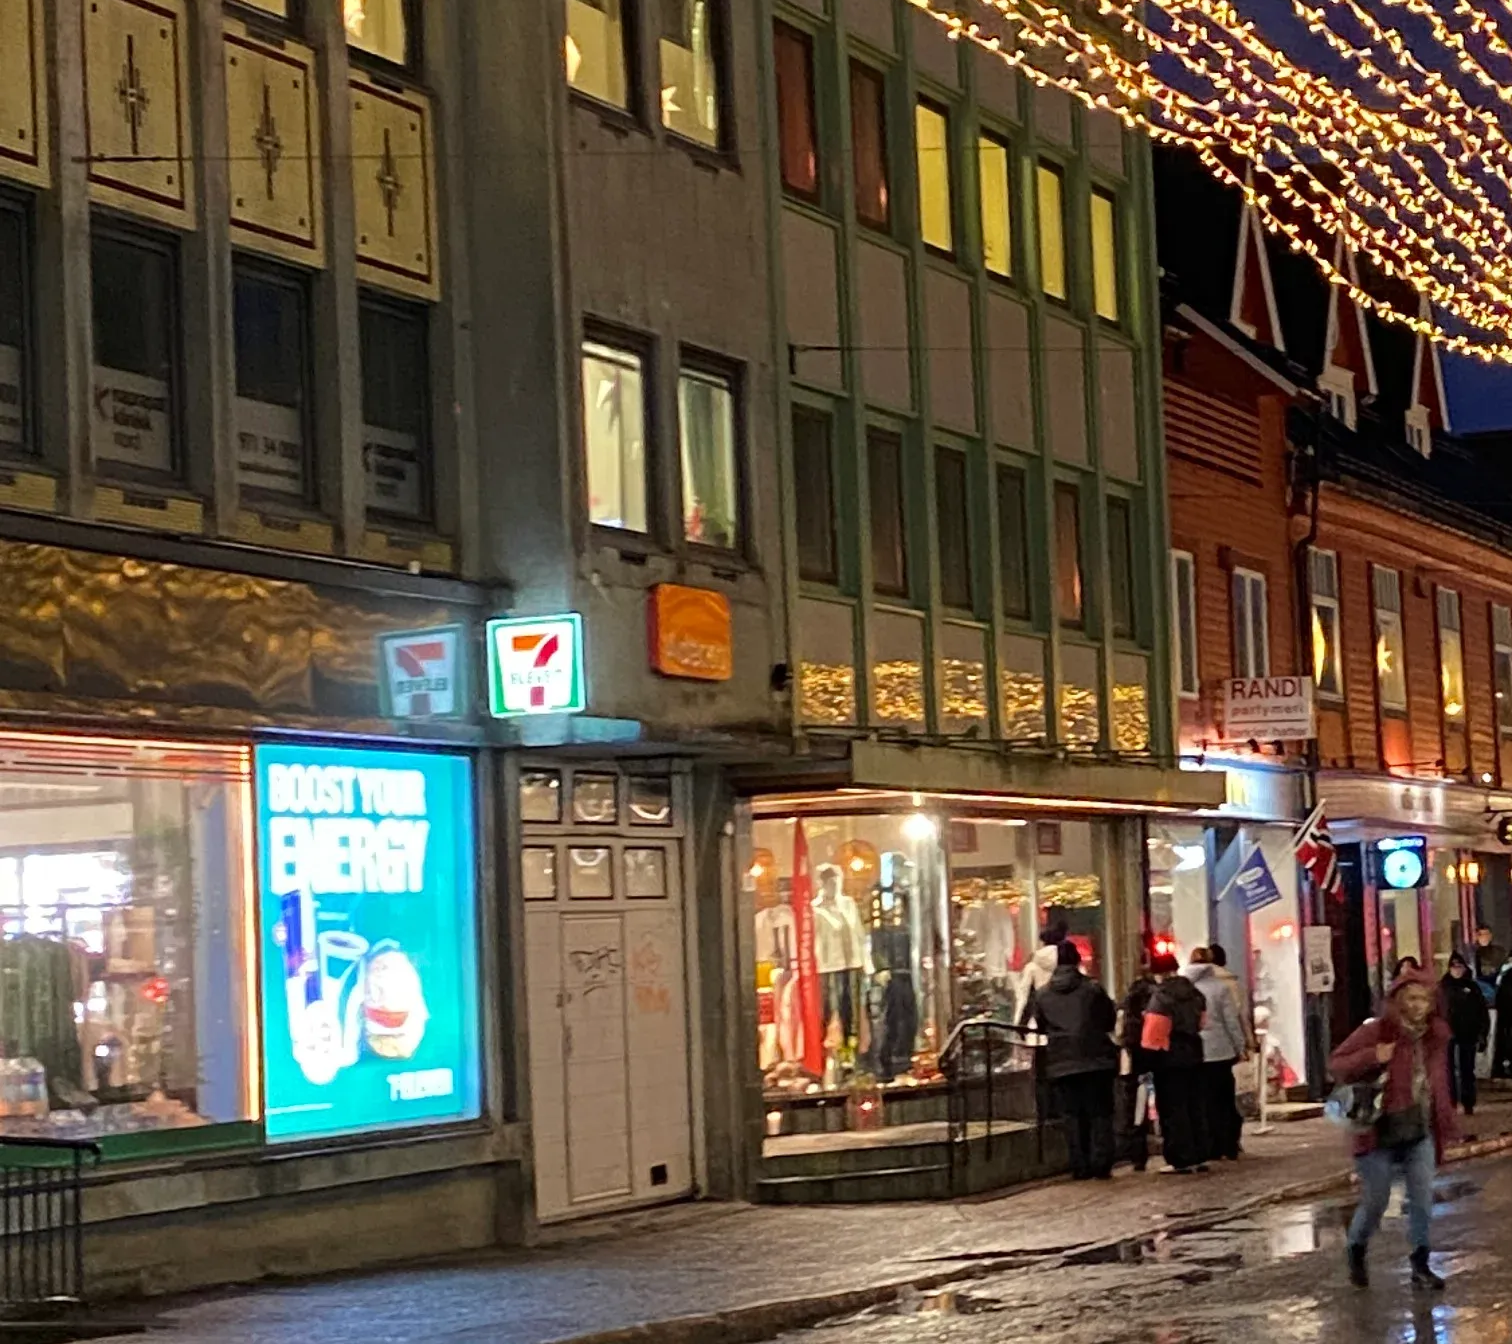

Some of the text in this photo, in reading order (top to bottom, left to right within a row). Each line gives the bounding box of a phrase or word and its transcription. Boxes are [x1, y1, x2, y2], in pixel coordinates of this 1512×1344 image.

[511, 633, 559, 707] 7
[1231, 678, 1304, 700] RANDI
[268, 763, 427, 816] BOOST YOUR
[269, 816, 431, 895] ENERGY
